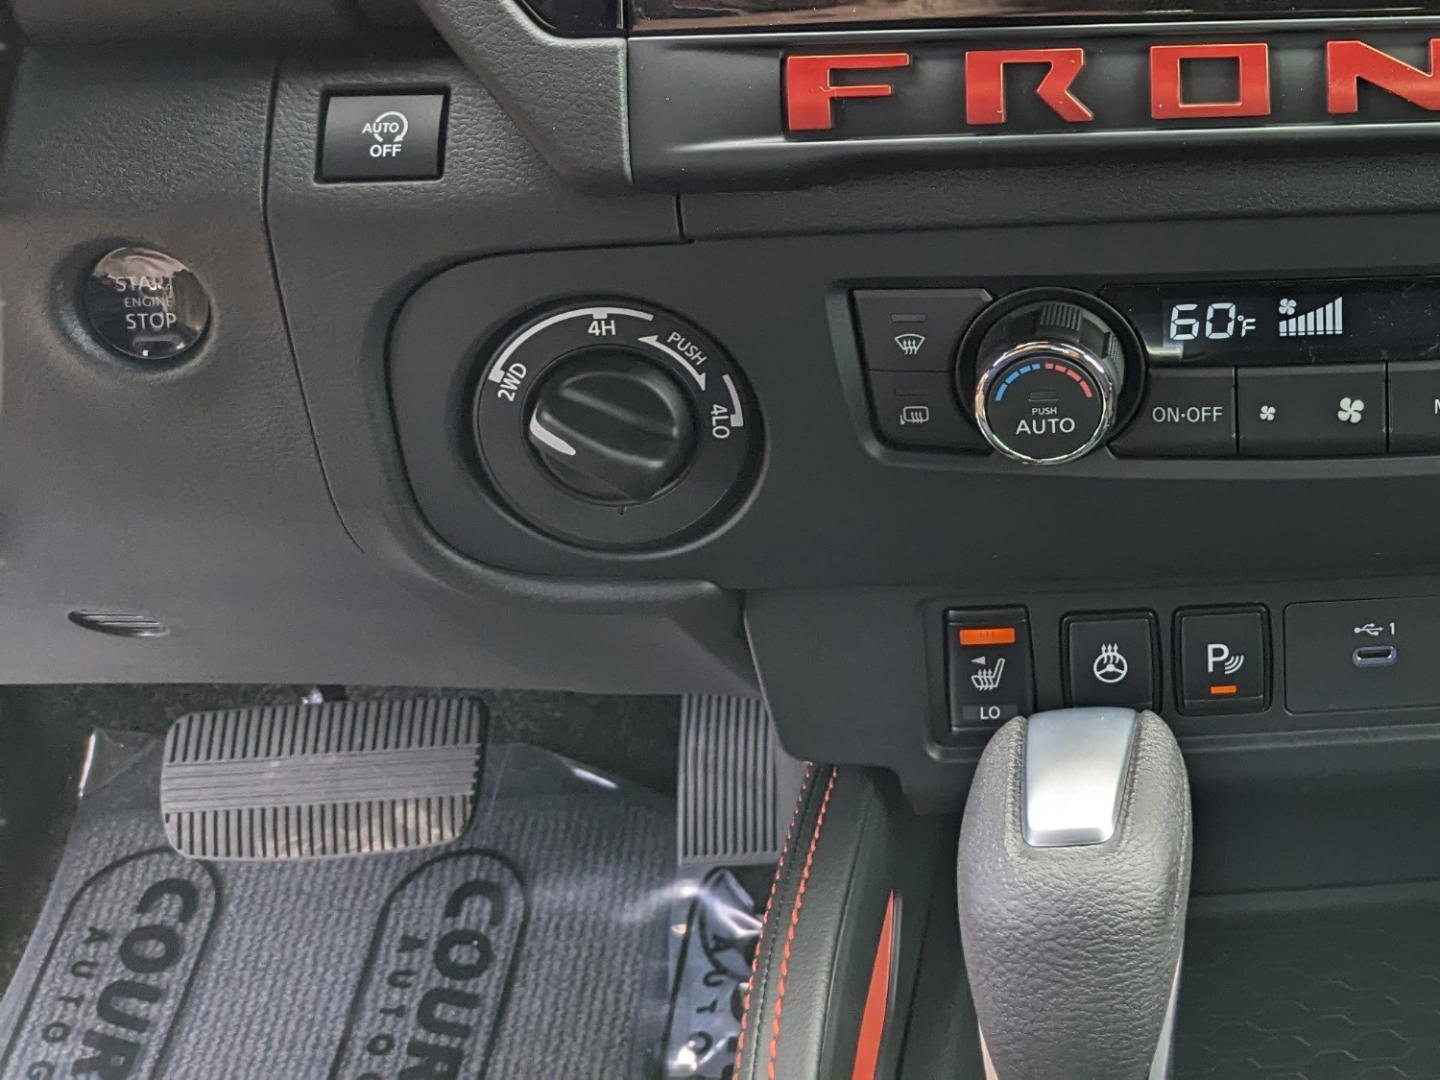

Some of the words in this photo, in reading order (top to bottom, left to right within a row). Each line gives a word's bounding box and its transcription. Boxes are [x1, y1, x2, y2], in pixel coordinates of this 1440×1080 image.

[361, 121, 399, 134] AUTO
[369, 143, 402, 158] OFF
[125, 312, 177, 330] STOP
[588, 320, 616, 335] 4H
[666, 331, 707, 366] PUSH
[497, 362, 527, 401] 2WD
[1031, 406, 1058, 416] PUSH
[709, 403, 731, 439] 4LO
[1015, 417, 1075, 435] AUTO
[979, 706, 1001, 720] LO
